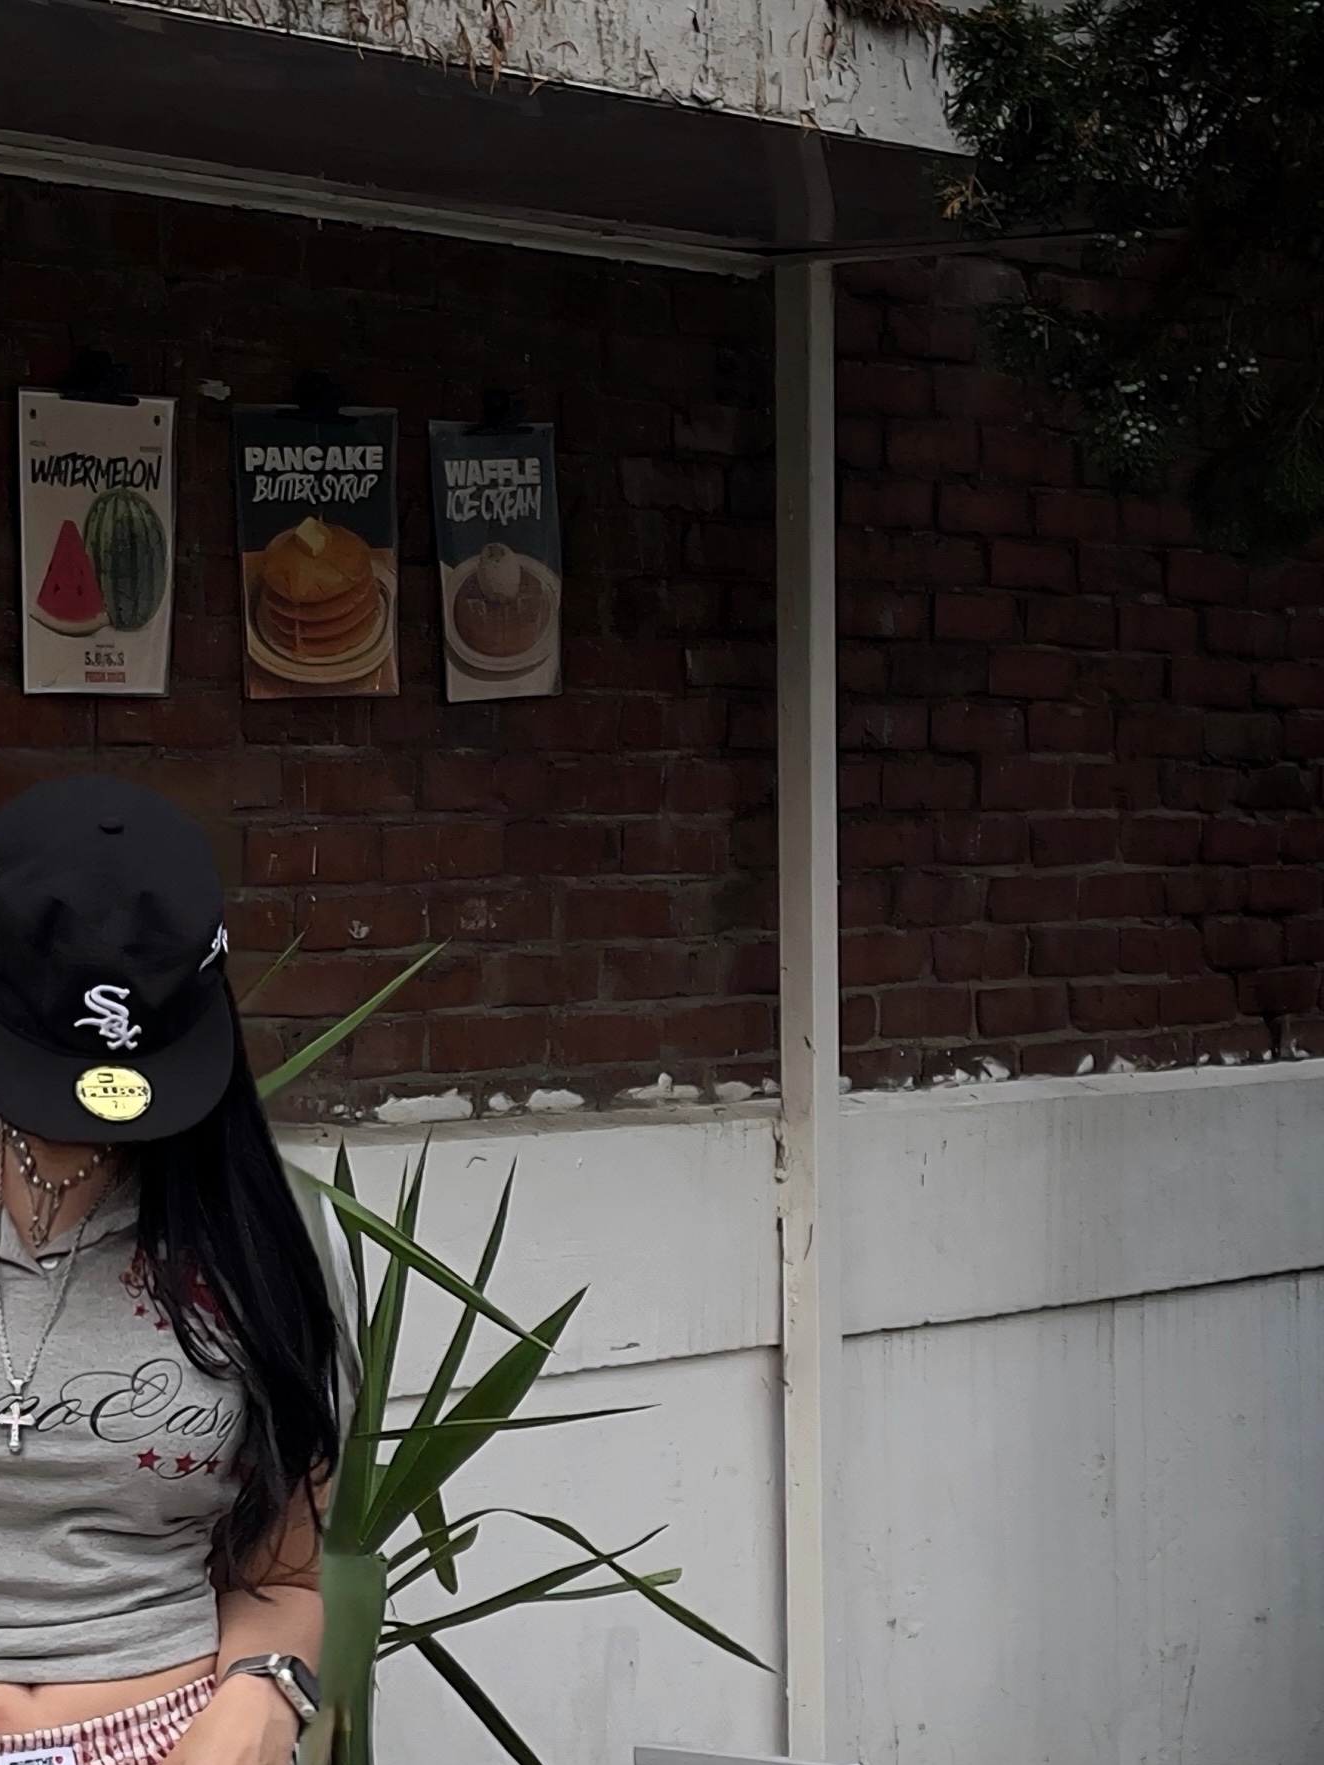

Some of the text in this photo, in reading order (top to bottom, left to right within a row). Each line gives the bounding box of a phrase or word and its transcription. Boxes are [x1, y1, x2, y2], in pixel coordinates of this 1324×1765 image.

[31, 452, 162, 493] WATERMELON
[244, 445, 385, 472] PANCAKE
[444, 457, 541, 487] WAFFLE
[252, 472, 317, 505] BUTTER
[320, 473, 379, 504] SYRUP
[446, 485, 542, 527] ICE CREAM
[60, 1358, 242, 1479] Easy
